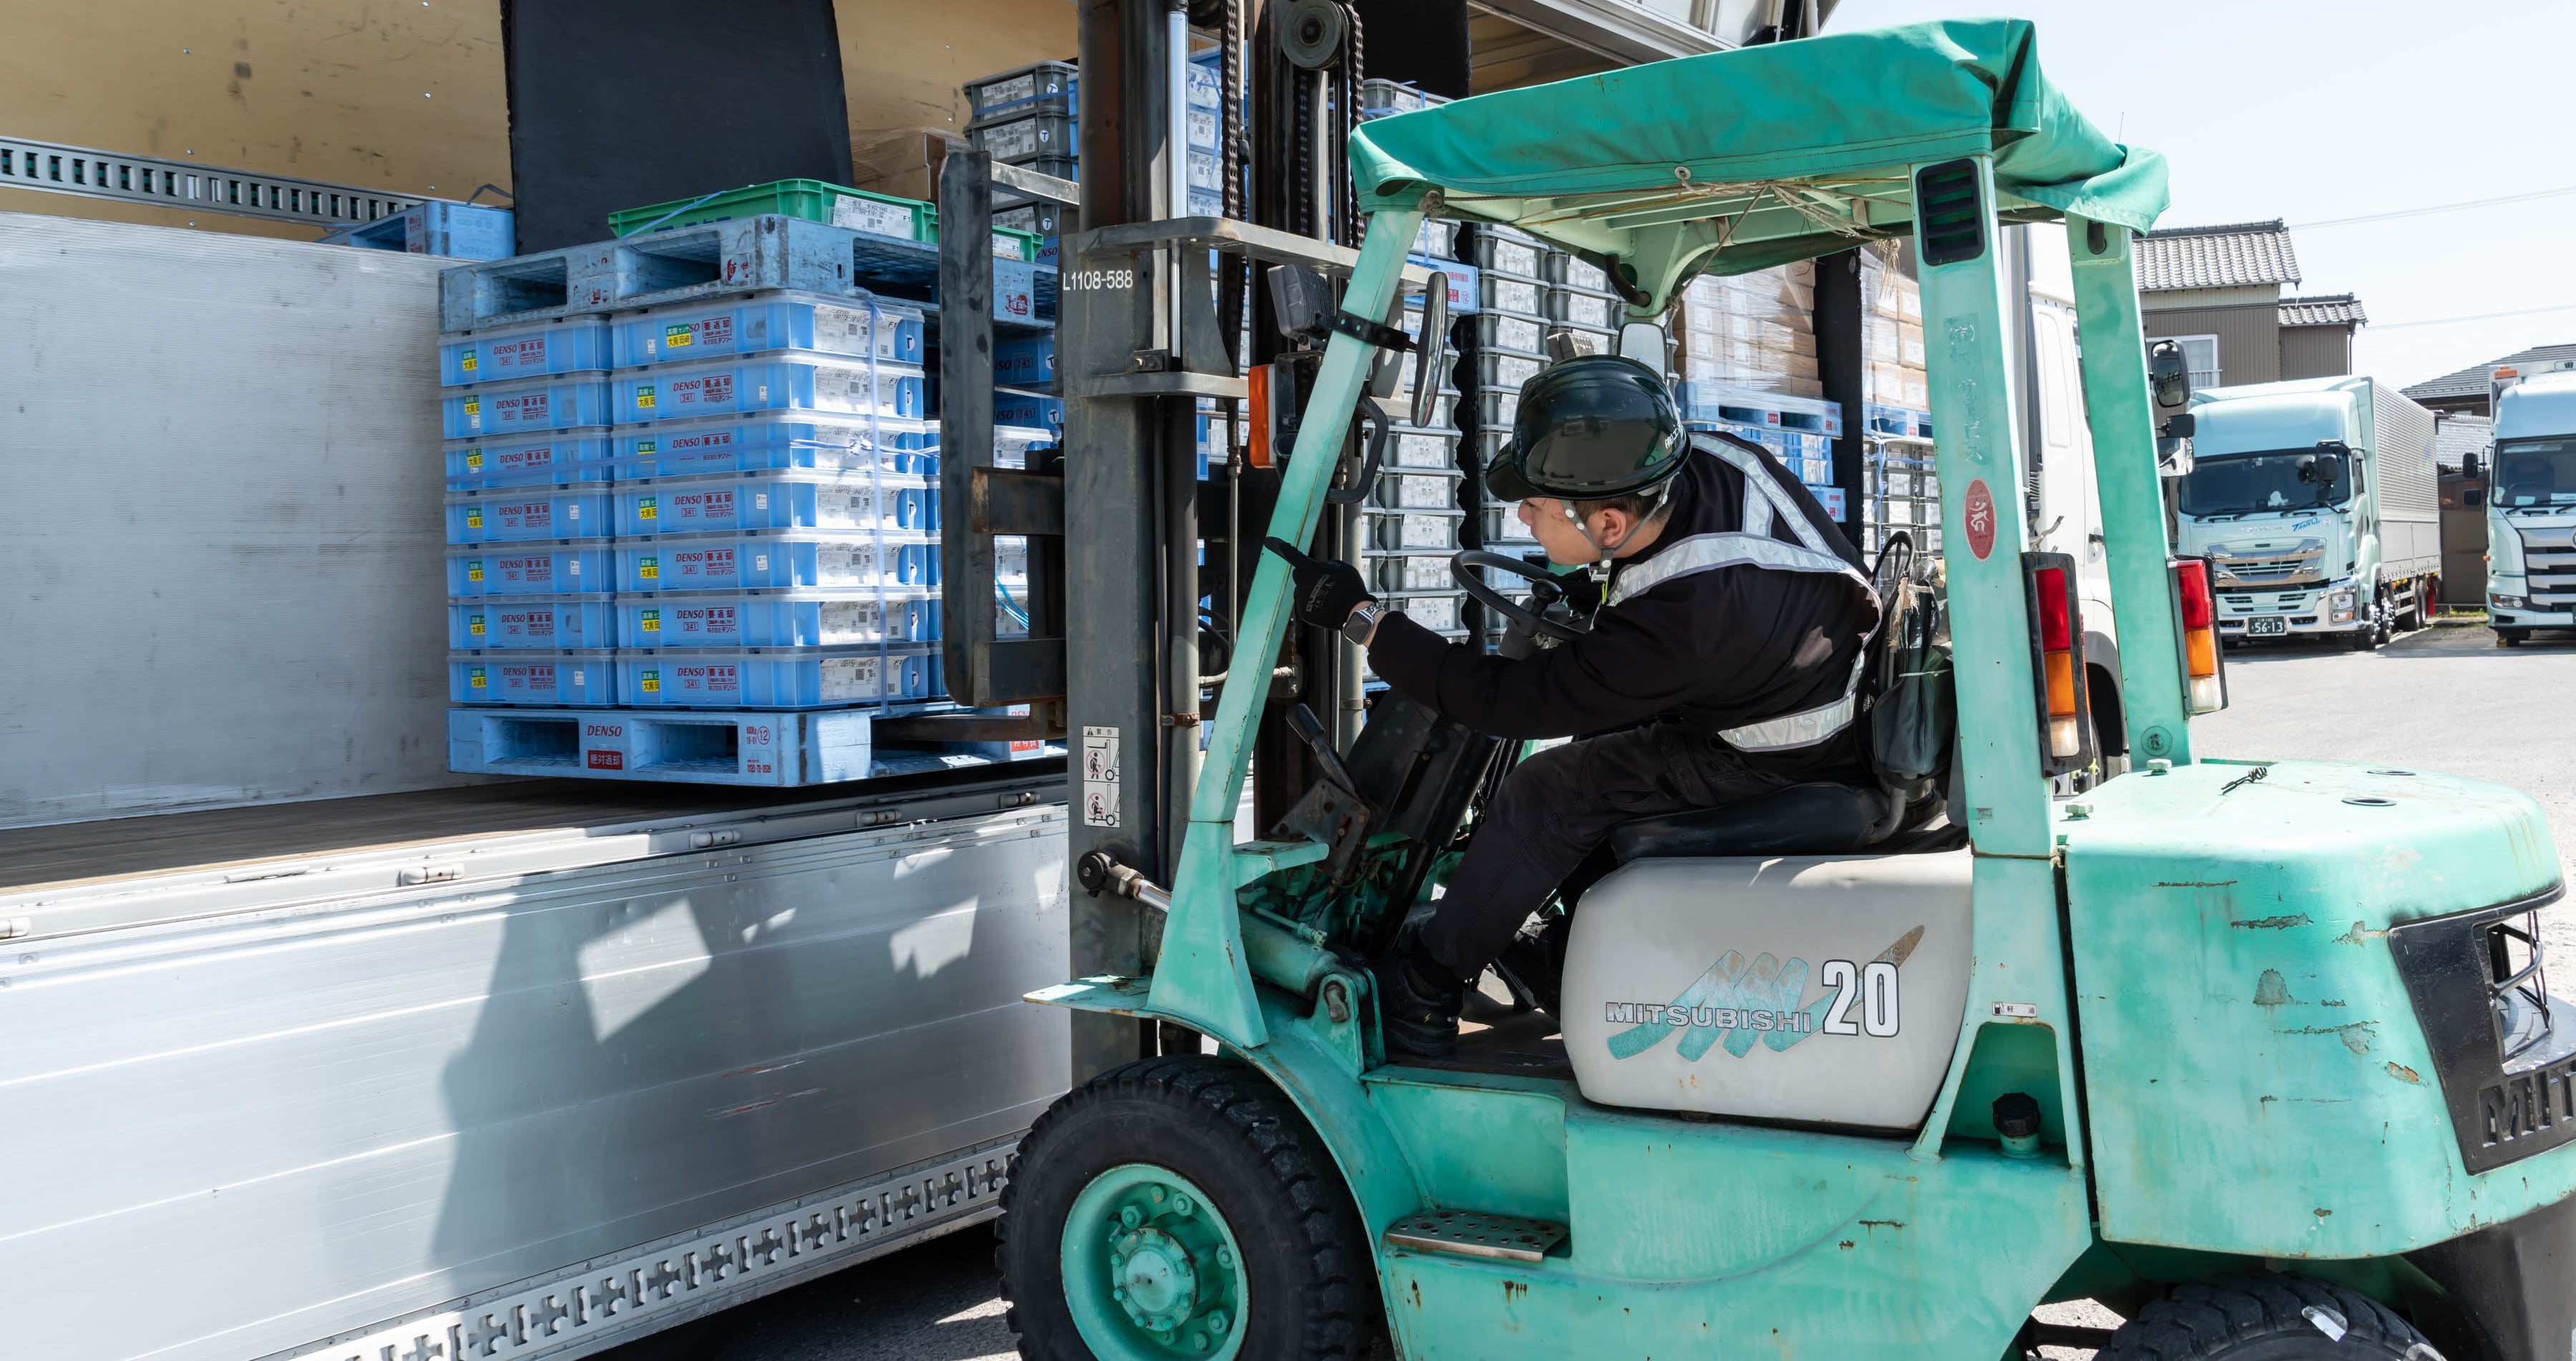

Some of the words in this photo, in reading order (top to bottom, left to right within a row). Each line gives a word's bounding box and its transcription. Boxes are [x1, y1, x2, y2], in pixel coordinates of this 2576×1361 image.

[1063, 270, 1133, 291] L1108-588
[704, 319, 730, 330] 要返却
[494, 344, 517, 355] DENSO
[520, 341, 543, 351] 要返却
[673, 380, 701, 391] DENSO
[704, 377, 730, 387] 要返却
[497, 399, 519, 409] DENSO
[523, 397, 546, 406] 要返却
[673, 437, 700, 448] DENSO
[703, 434, 729, 445] 要返却
[499, 453, 523, 463] DENSO
[527, 451, 550, 461] 要返却
[675, 495, 701, 505] DENSO
[706, 494, 731, 503] 要返却
[499, 507, 522, 515] DENSO
[526, 504, 549, 514] 要返却
[675, 553, 703, 562] DENSO
[707, 552, 732, 561] 要返却
[677, 610, 703, 619] DENSO
[708, 610, 733, 618] 要返却
[678, 668, 704, 676] DENSO
[709, 668, 734, 676] 要返却
[587, 725, 622, 737] DENSO
[1605, 1002, 1812, 1034] MITSUBISHI
[1822, 959, 1900, 1038] 20
